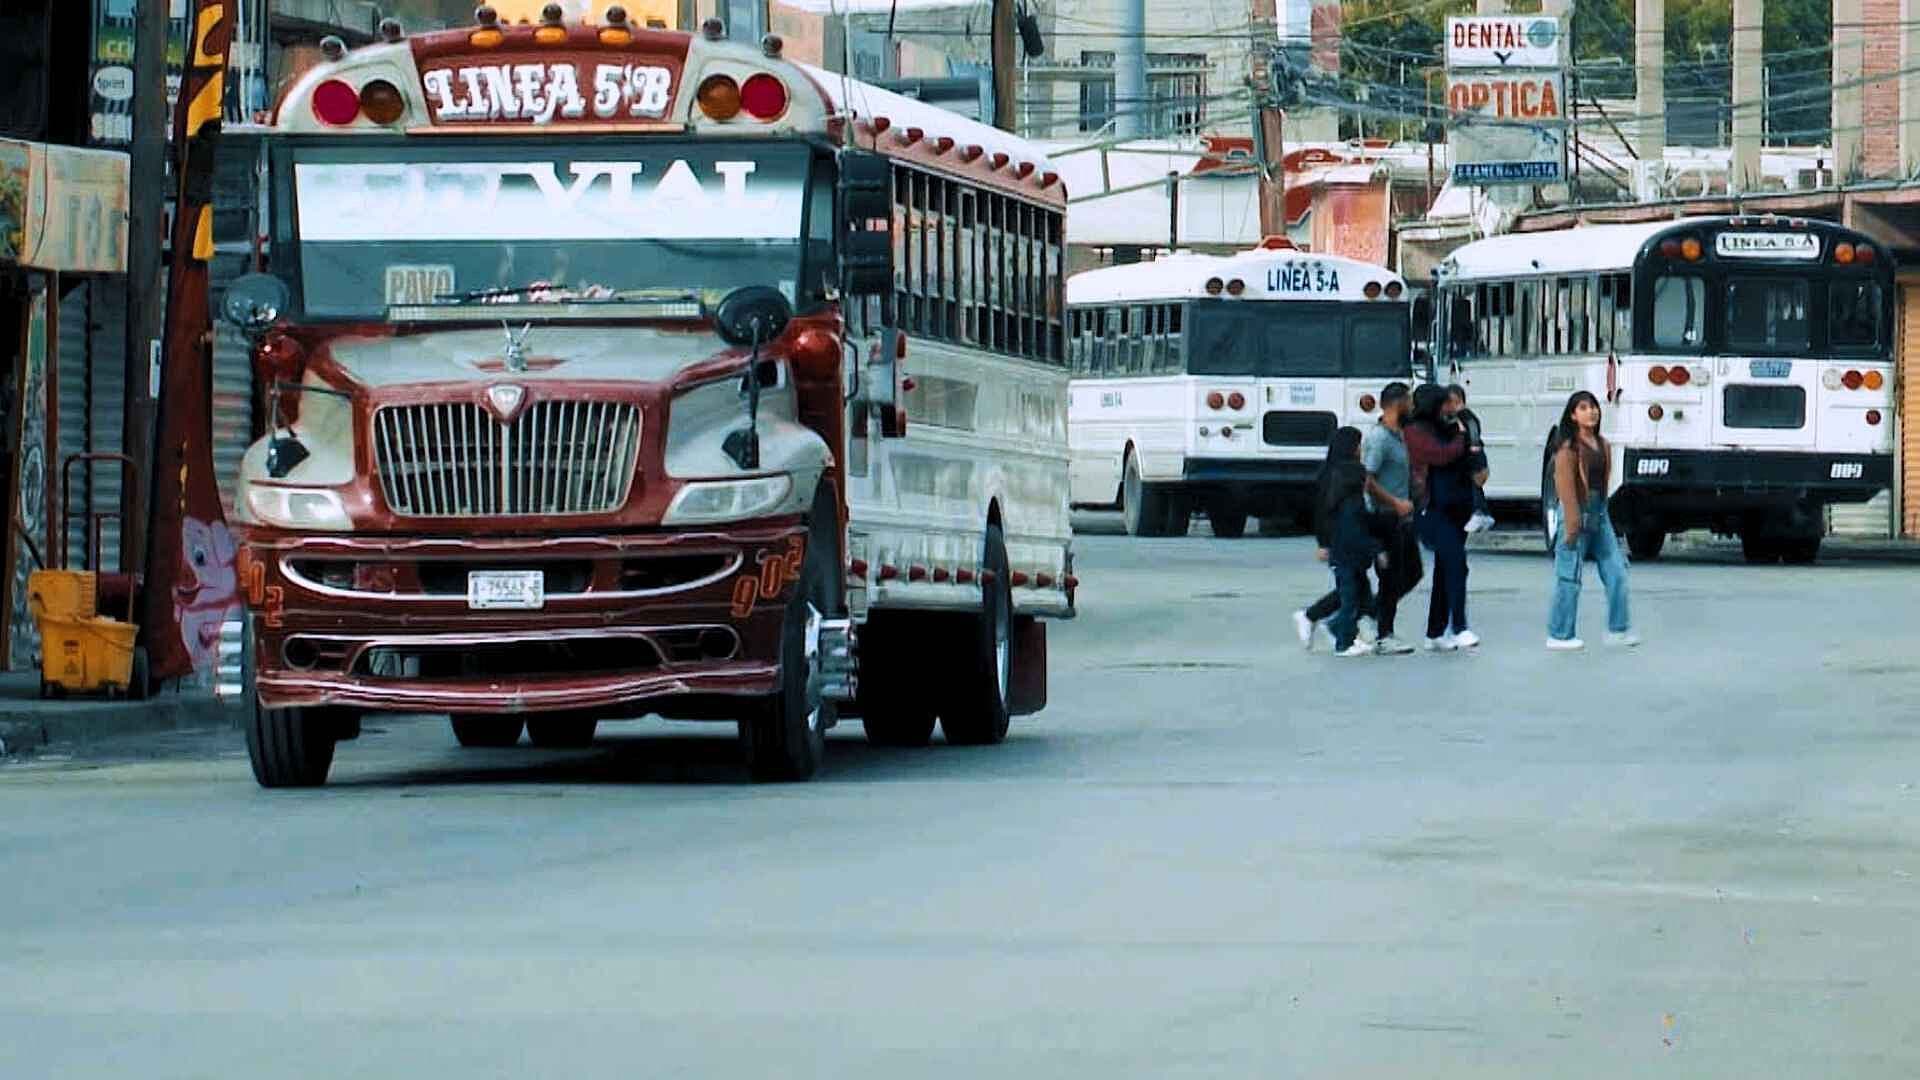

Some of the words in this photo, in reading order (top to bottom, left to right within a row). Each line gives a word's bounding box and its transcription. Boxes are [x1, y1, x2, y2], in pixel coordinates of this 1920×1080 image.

[1454, 24, 1527, 48] DENTAL
[423, 63, 586, 124] LINEA
[1450, 80, 1558, 119] OPTICA
[1267, 269, 1312, 291] LINEA
[1316, 269, 1340, 292] 5-A
